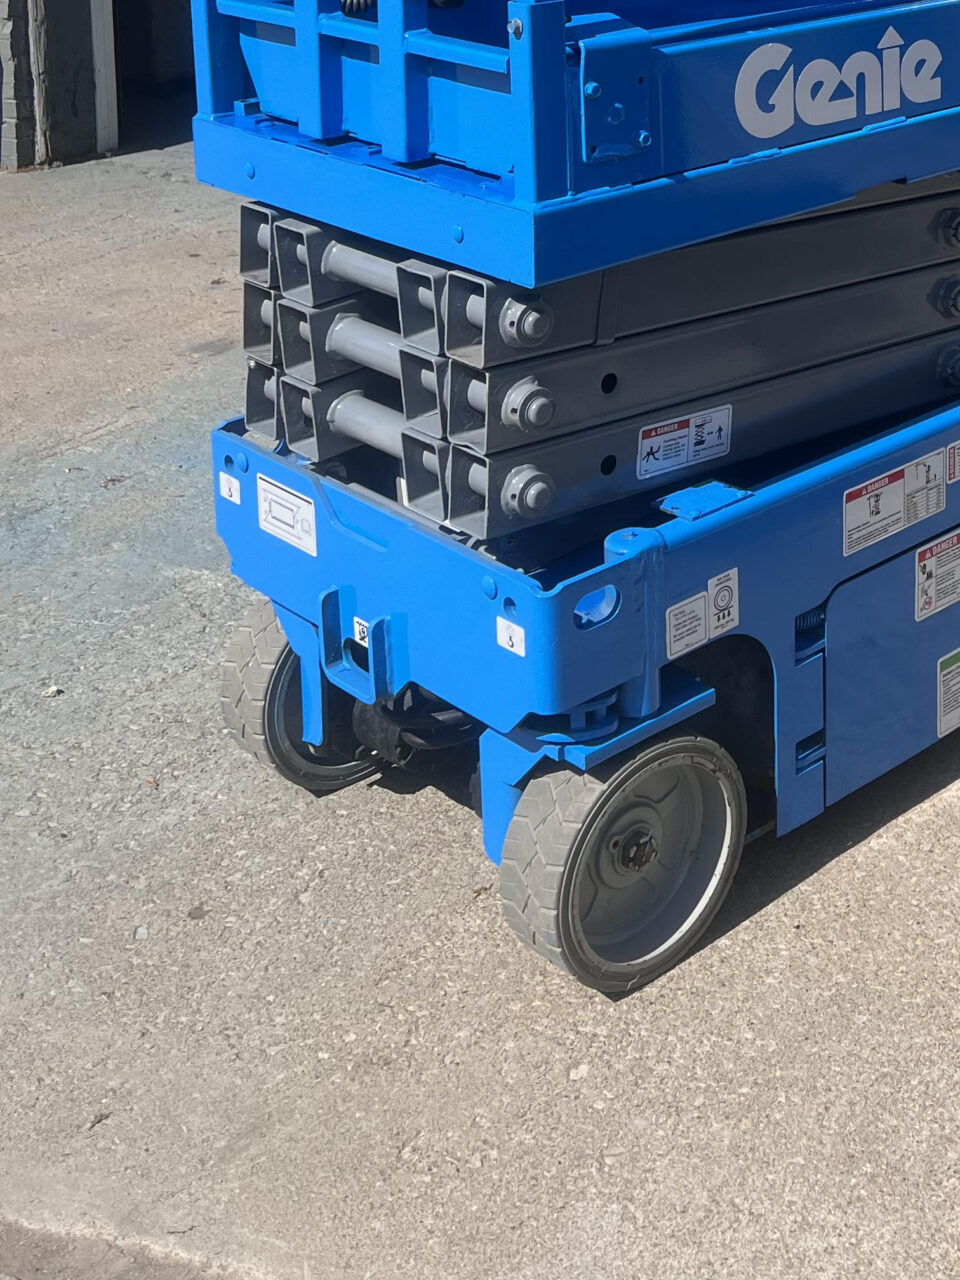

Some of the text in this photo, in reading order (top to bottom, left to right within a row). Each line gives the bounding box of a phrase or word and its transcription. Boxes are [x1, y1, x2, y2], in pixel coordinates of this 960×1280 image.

[735, 26, 942, 139] Genie
[657, 423, 679, 434] DANGER
[867, 477, 889, 493] DANGER
[932, 536, 958, 556] DANGER
